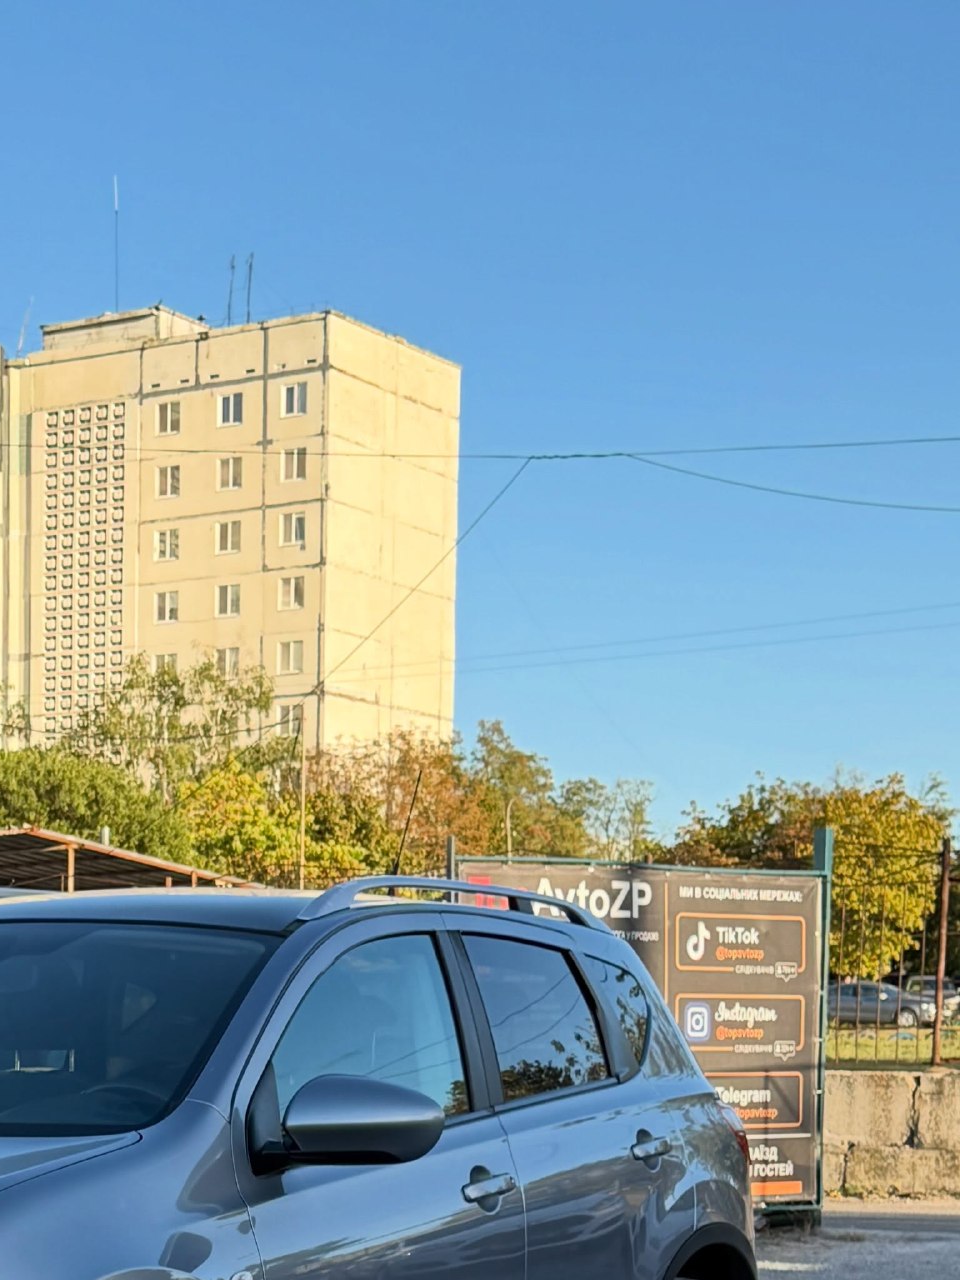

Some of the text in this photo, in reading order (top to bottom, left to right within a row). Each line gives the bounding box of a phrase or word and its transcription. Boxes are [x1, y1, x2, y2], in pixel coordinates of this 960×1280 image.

[694, 887, 701, 898] В
[715, 926, 760, 945] TikTok
[714, 1001, 778, 1028] Instagram
[714, 1086, 771, 1107] Telegram
[754, 1159, 794, 1178] ГОСТЕЙ
